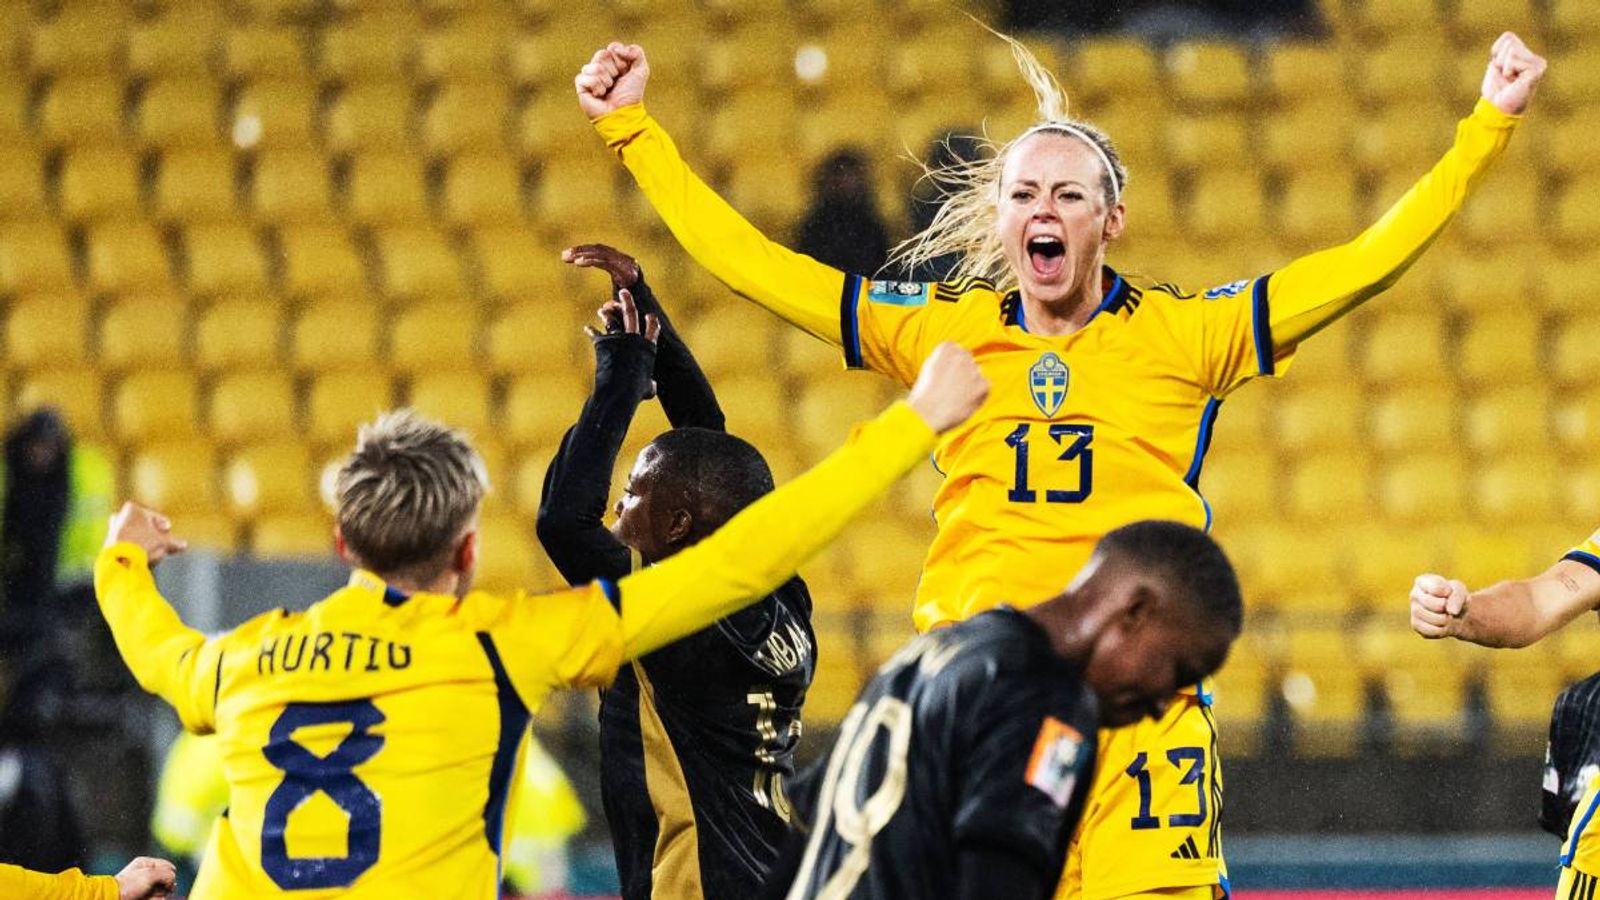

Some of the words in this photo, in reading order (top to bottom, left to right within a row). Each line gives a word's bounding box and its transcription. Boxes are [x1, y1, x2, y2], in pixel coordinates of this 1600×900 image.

[1005, 423, 1095, 503] 13
[258, 632, 411, 674] HURTIG
[261, 698, 386, 891] 8
[786, 695, 912, 900] 19
[1125, 746, 1207, 830] 13
